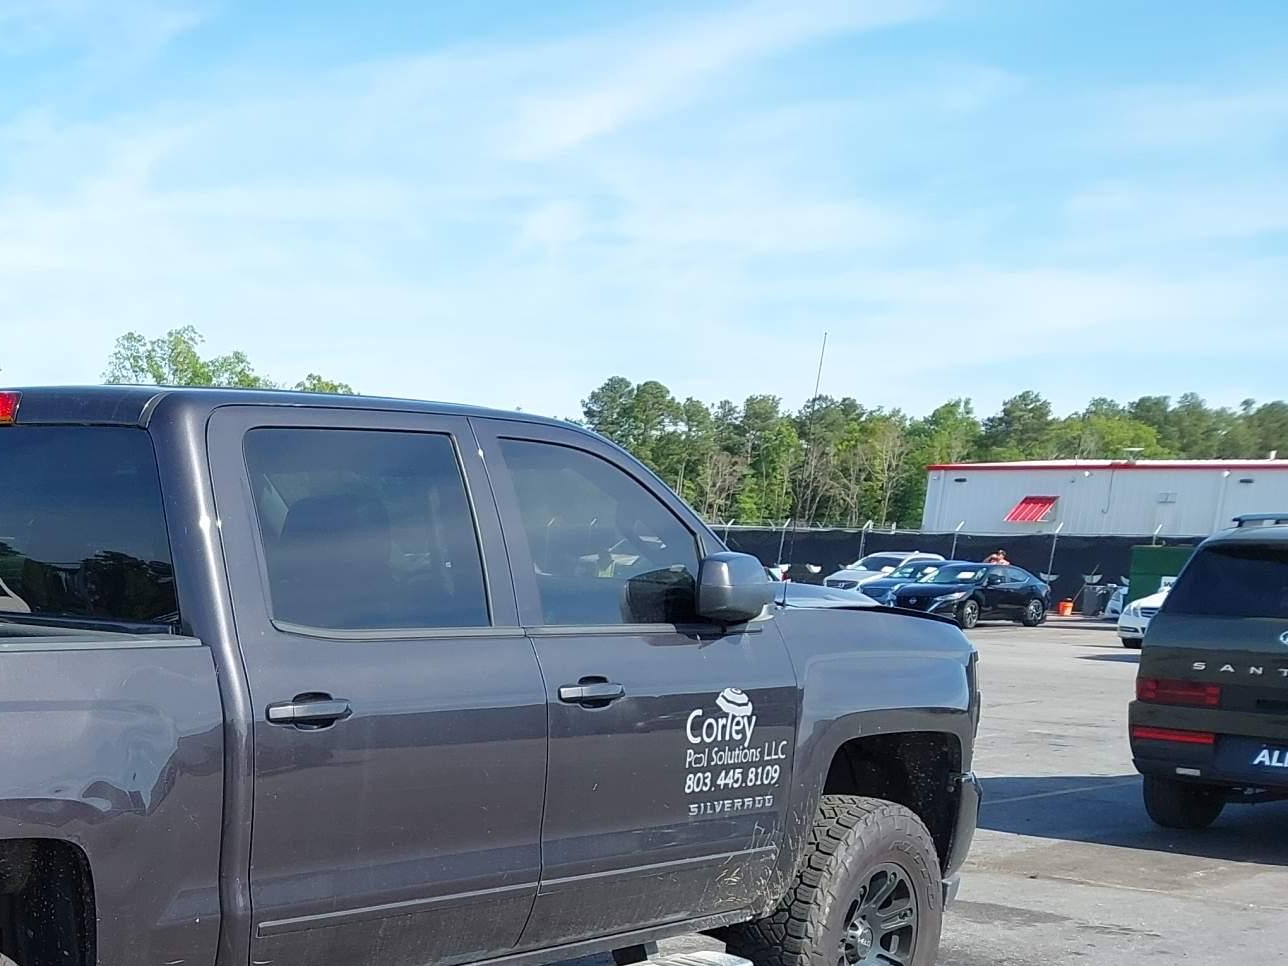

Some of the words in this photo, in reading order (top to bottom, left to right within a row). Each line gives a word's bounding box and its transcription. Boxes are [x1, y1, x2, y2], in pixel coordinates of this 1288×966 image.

[686, 709, 756, 747] Corley
[711, 746, 761, 765] Solutions
[764, 741, 787, 761] LLC
[685, 765, 780, 793] 803.445.8109
[688, 795, 773, 816] SILVERADO
